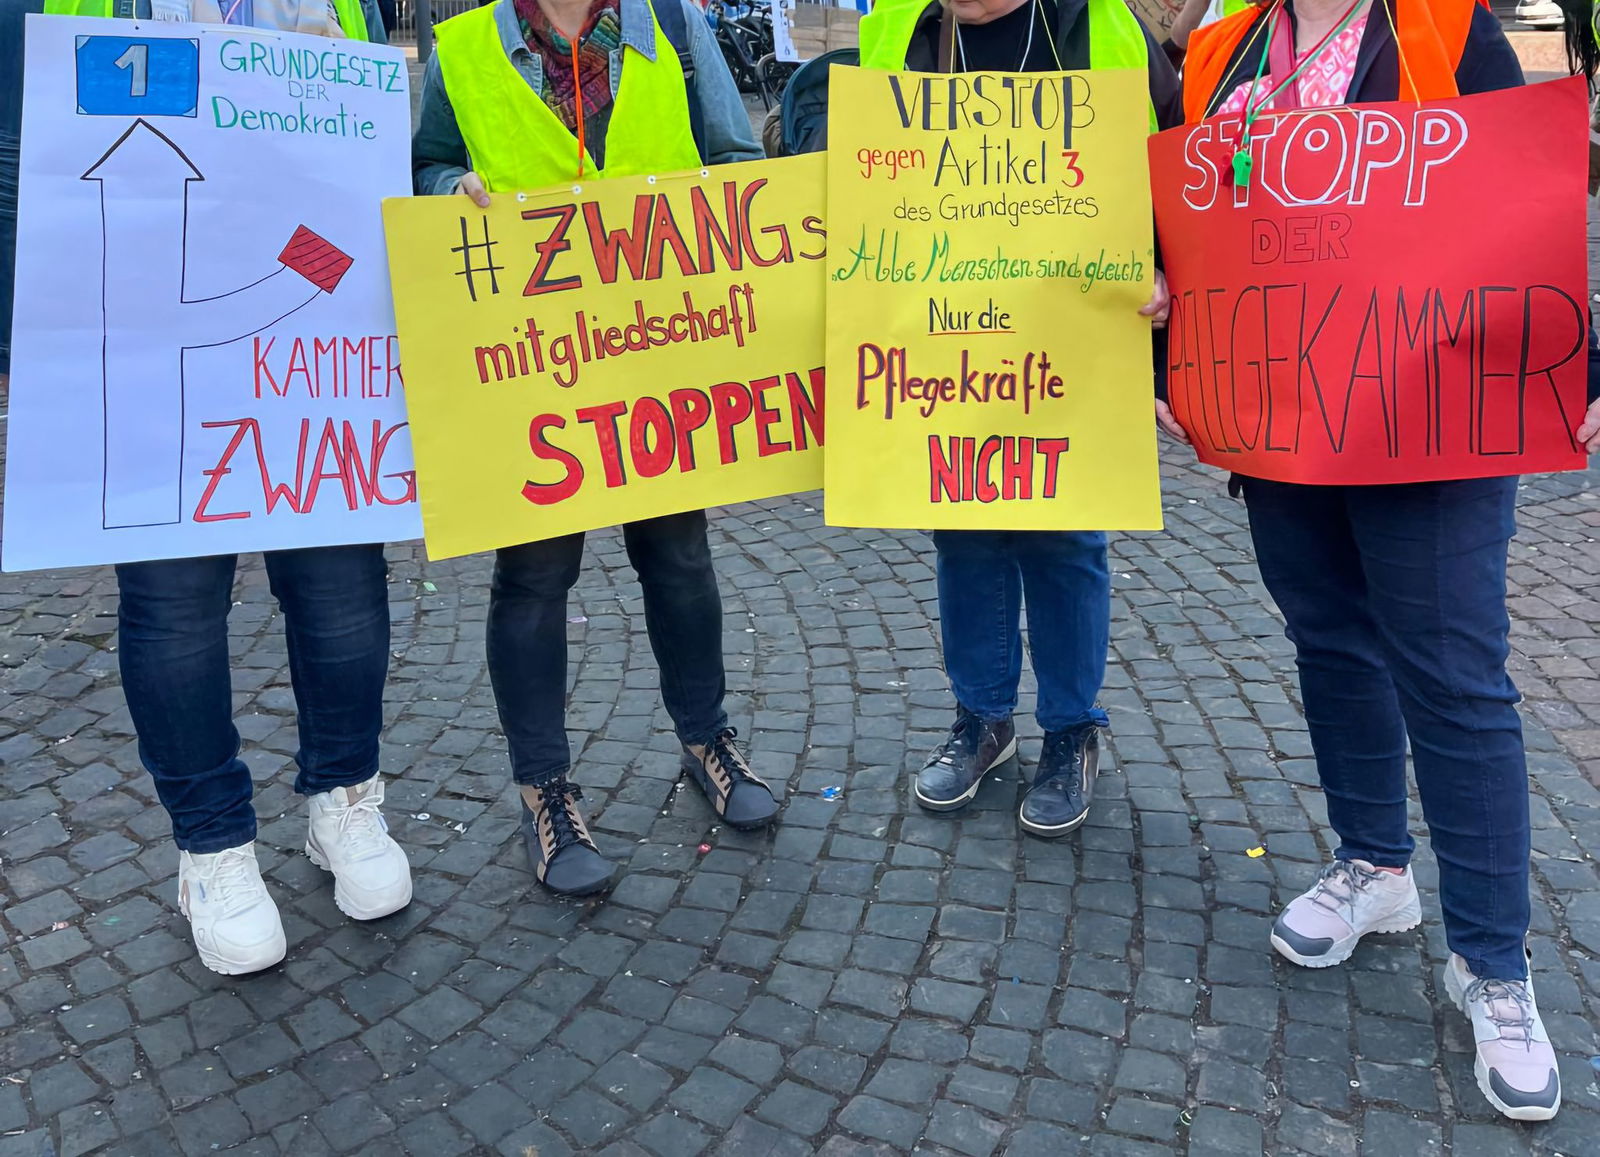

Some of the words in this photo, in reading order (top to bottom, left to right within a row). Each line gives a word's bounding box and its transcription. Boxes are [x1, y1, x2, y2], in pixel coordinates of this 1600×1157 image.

[114, 44, 149, 97] 1
[219, 39, 404, 93] GRUNDGESETZ
[287, 80, 330, 101] DER
[211, 96, 377, 140] Demokratie
[857, 147, 926, 181] gegen
[933, 134, 1047, 187] Artikel
[1060, 151, 1085, 188] 3
[1181, 108, 1469, 211] STOPP
[893, 196, 932, 222] des
[938, 190, 1099, 227] Grundgesetzes
[921, 230, 1034, 283] Menschen
[1036, 250, 1080, 280] sind
[1251, 212, 1353, 265] DER
[474, 282, 757, 388] mitgliedschaft
[928, 297, 970, 333] Nur
[977, 297, 1012, 331] die
[253, 336, 404, 399] KAMMER
[856, 342, 1065, 420] Pflegekräfte
[1168, 281, 1585, 459] PFLEGEKAMMER
[520, 366, 826, 506] STOPPEN
[193, 417, 417, 523] ZWANG
[928, 434, 1069, 504] NICHT
